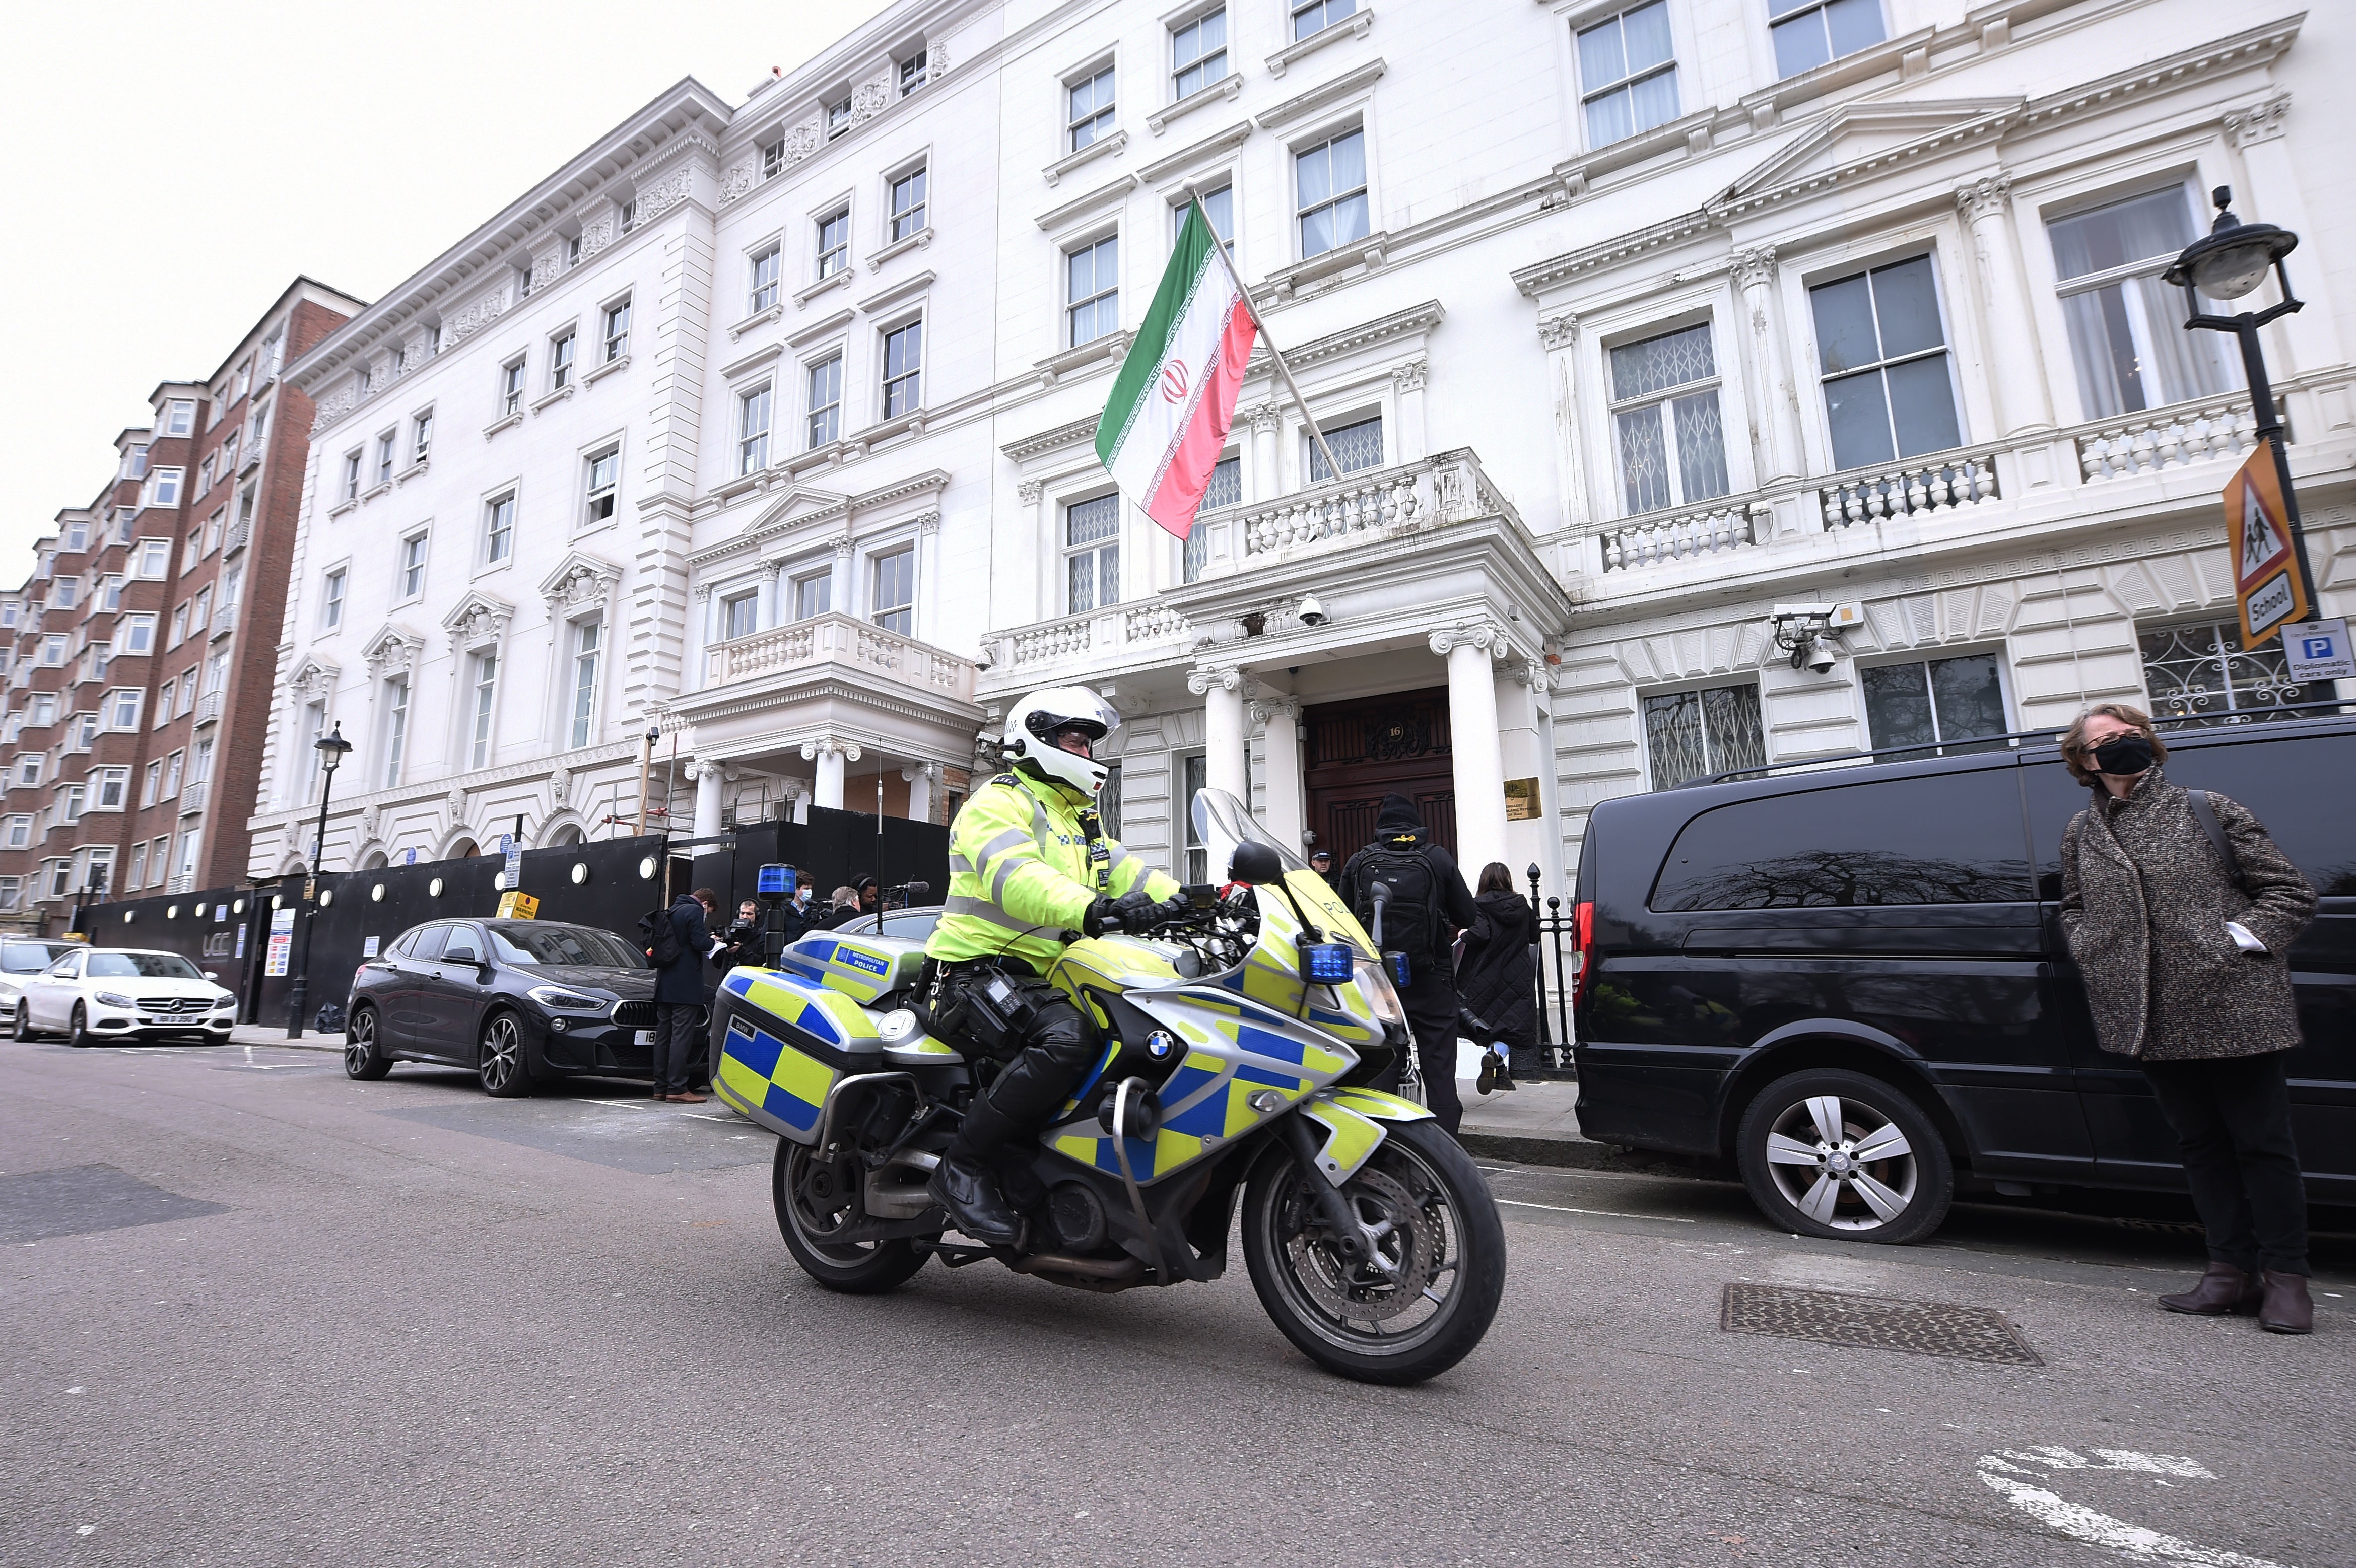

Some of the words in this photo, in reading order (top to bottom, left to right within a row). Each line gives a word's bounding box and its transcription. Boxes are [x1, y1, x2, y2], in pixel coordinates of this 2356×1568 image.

[2252, 584, 2288, 622] School
[2309, 640, 2328, 656] P
[2293, 660, 2351, 670] Diplomatic
[1390, 726, 1400, 736] 16
[516, 906, 534, 917] WARNING
[1323, 901, 1351, 915] POL
[852, 952, 885, 966] METROPOLITAN
[854, 960, 878, 972] POLICE
[736, 1022, 750, 1034] BMW
[645, 1032, 655, 1043] 18
[1150, 1032, 1172, 1042] BMW
[1288, 1202, 1300, 1229] brembo
